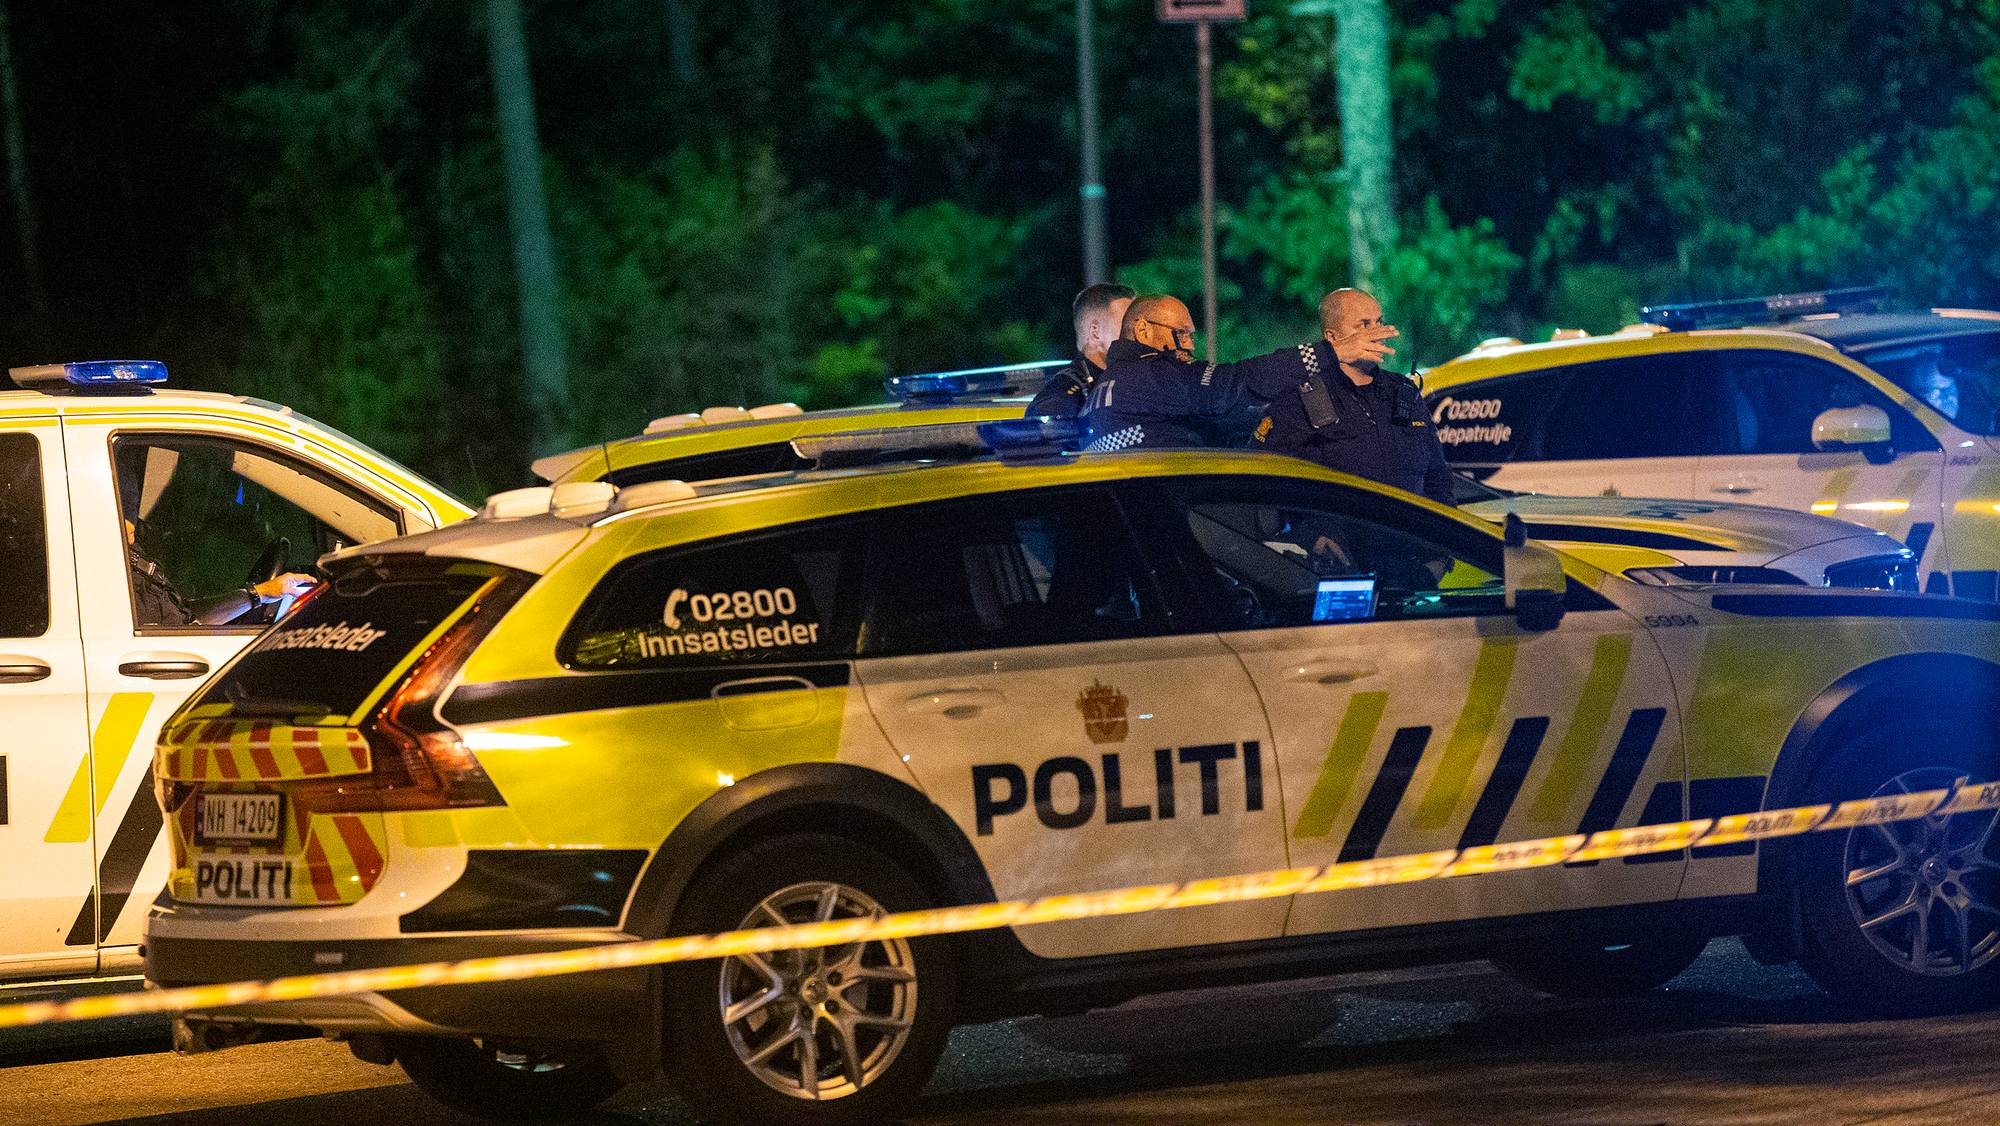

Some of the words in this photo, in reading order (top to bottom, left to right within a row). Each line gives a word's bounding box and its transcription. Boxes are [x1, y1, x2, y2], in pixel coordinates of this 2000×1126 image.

[1447, 399, 1502, 420] 02800
[1437, 423, 1512, 447] depatrulje
[689, 587, 797, 622] 02800
[638, 619, 819, 658] Innsatsleder
[971, 740, 1264, 837] POLITI
[206, 799, 225, 832] NH
[232, 799, 276, 834] 14209
[196, 860, 293, 900] POLITI
